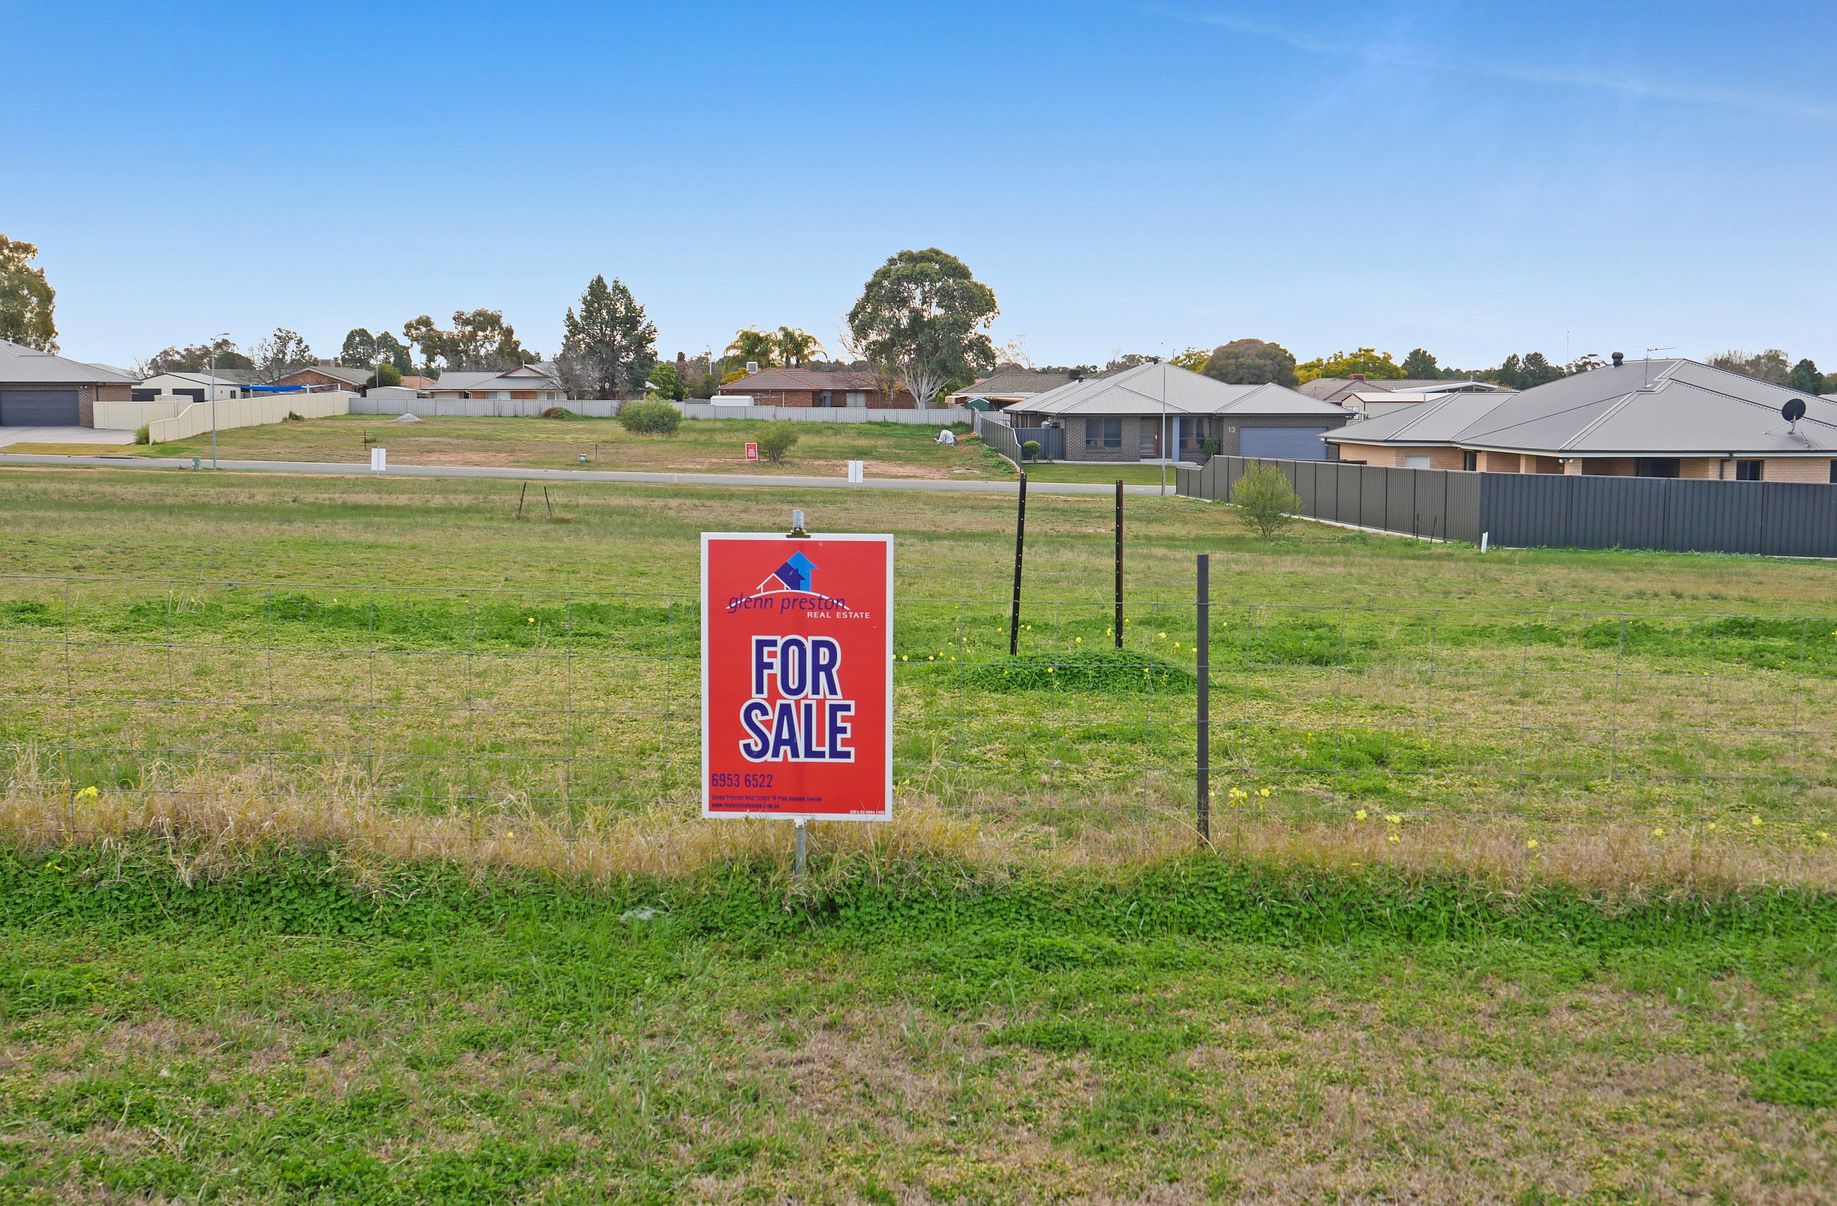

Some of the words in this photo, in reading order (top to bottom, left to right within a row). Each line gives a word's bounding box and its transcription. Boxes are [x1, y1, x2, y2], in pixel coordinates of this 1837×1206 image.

[728, 592, 774, 614] glenn
[780, 594, 845, 613] preston
[807, 611, 832, 619] REAL
[836, 611, 871, 619] ESTATE
[752, 635, 843, 700] FOR
[739, 698, 855, 763] SALE
[712, 773, 740, 787] 6953
[744, 773, 773, 788] 6522
